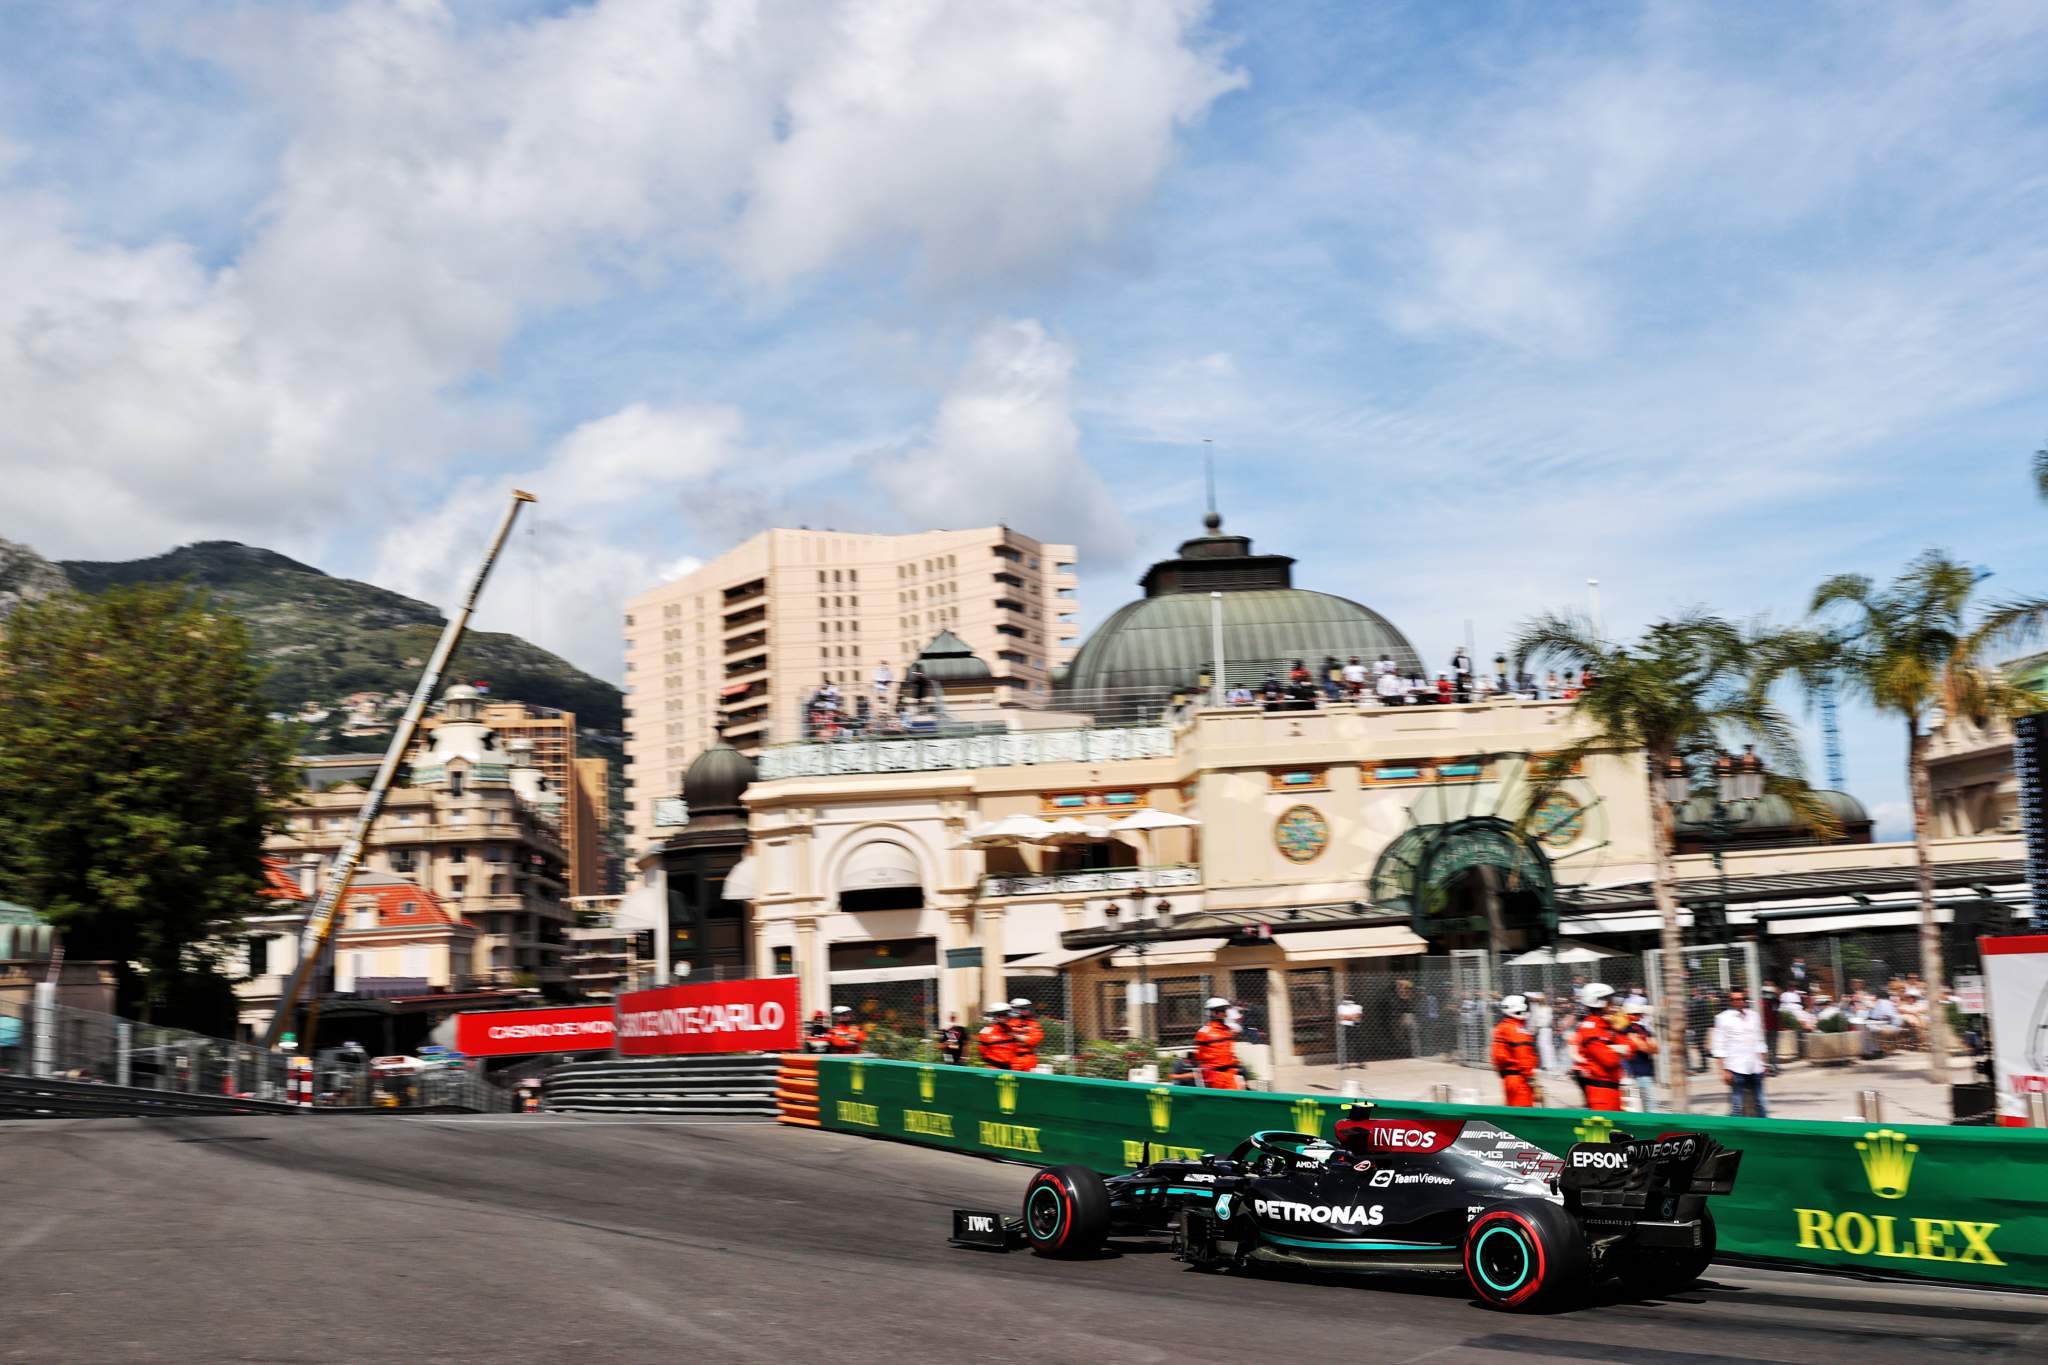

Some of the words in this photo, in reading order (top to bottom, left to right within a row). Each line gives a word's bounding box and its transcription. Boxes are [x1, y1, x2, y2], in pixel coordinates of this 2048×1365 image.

[488, 1023, 553, 1040] CASINO
[979, 1121, 1043, 1153] ROLEX
[1373, 1128, 1437, 1148] INEOS
[1465, 1150, 1504, 1159] AMG
[1639, 1142, 1681, 1160] INEOS
[1573, 1152, 1629, 1169] EPSON
[1395, 1172, 1455, 1186] TeamViewer
[1254, 1199, 1384, 1226] PETRONAS
[968, 1216, 994, 1233] IWC
[1793, 1208, 2008, 1266] ROLEX
